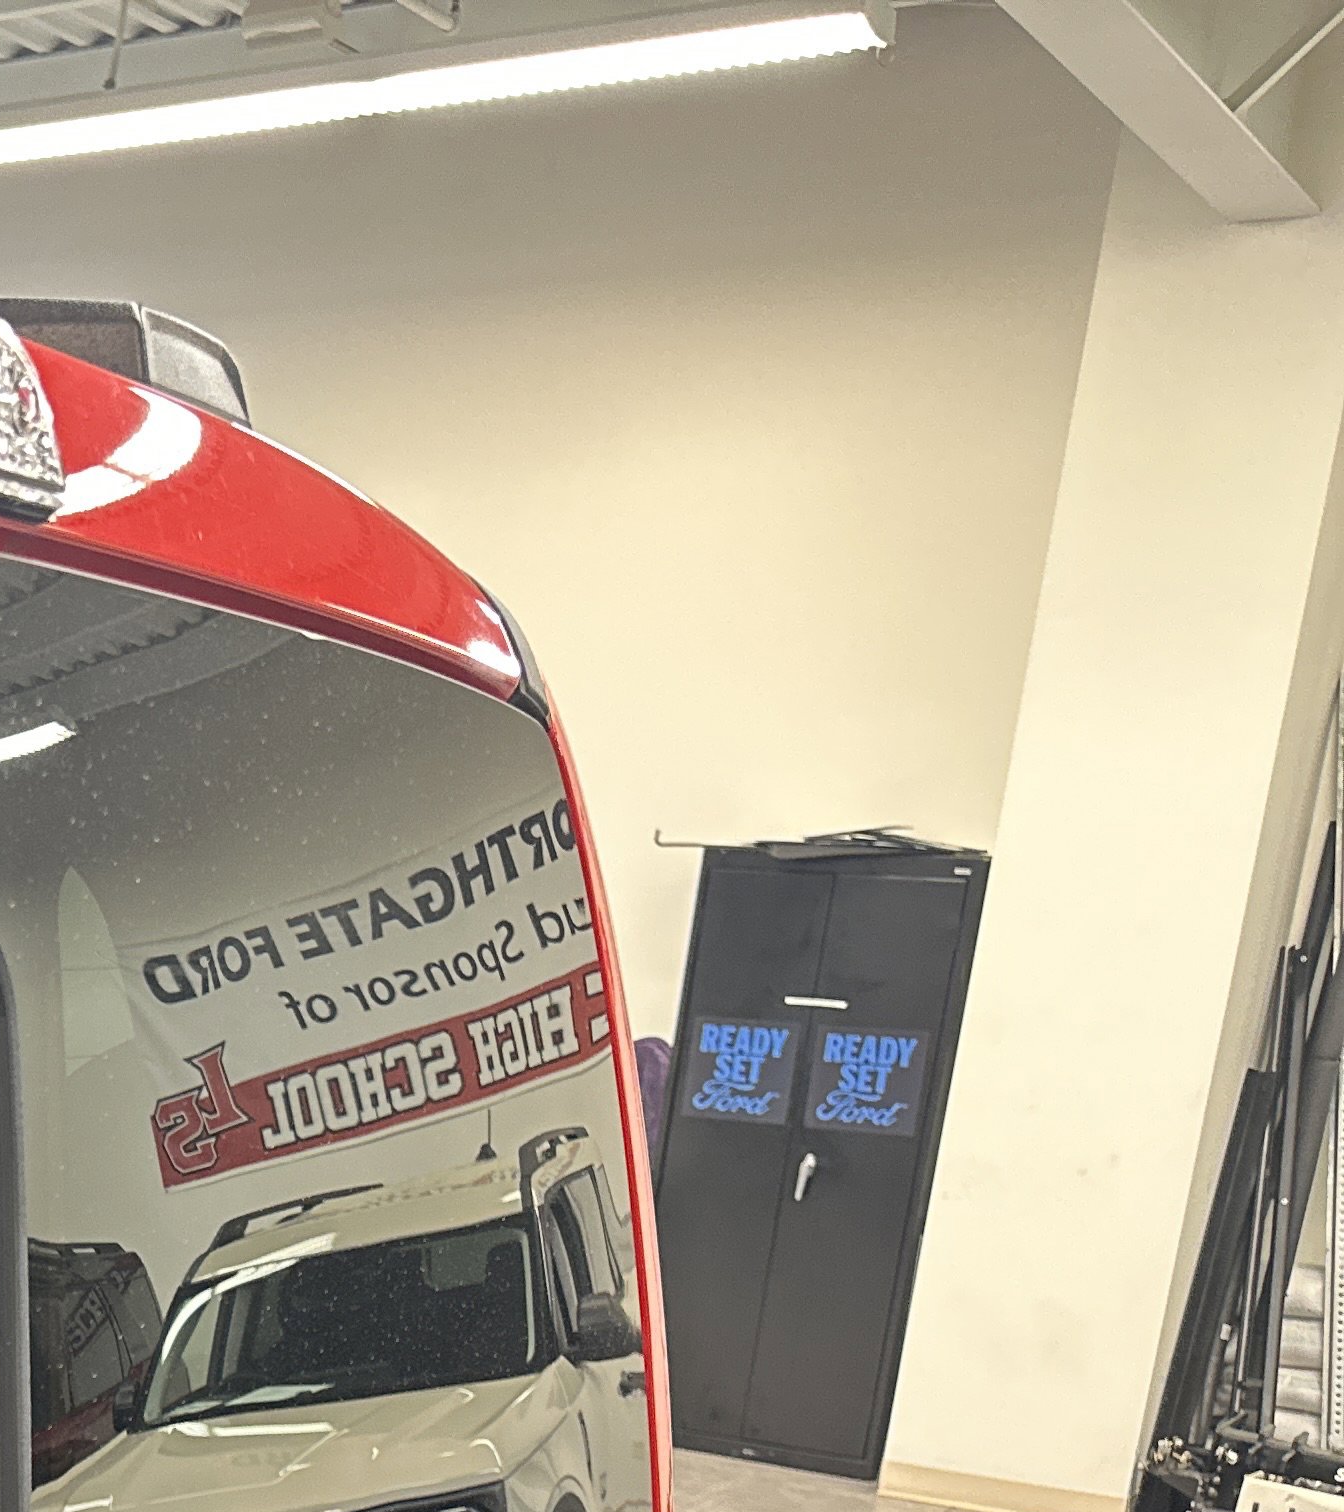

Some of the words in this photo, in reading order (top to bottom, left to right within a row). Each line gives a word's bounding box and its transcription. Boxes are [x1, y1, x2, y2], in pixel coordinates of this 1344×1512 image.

[699, 1023, 789, 1058] READY
[823, 1032, 918, 1068] READY
[713, 1054, 765, 1084] SET
[838, 1064, 892, 1094] SET
[692, 1079, 780, 1115] Ford
[816, 1089, 908, 1127] Ford
